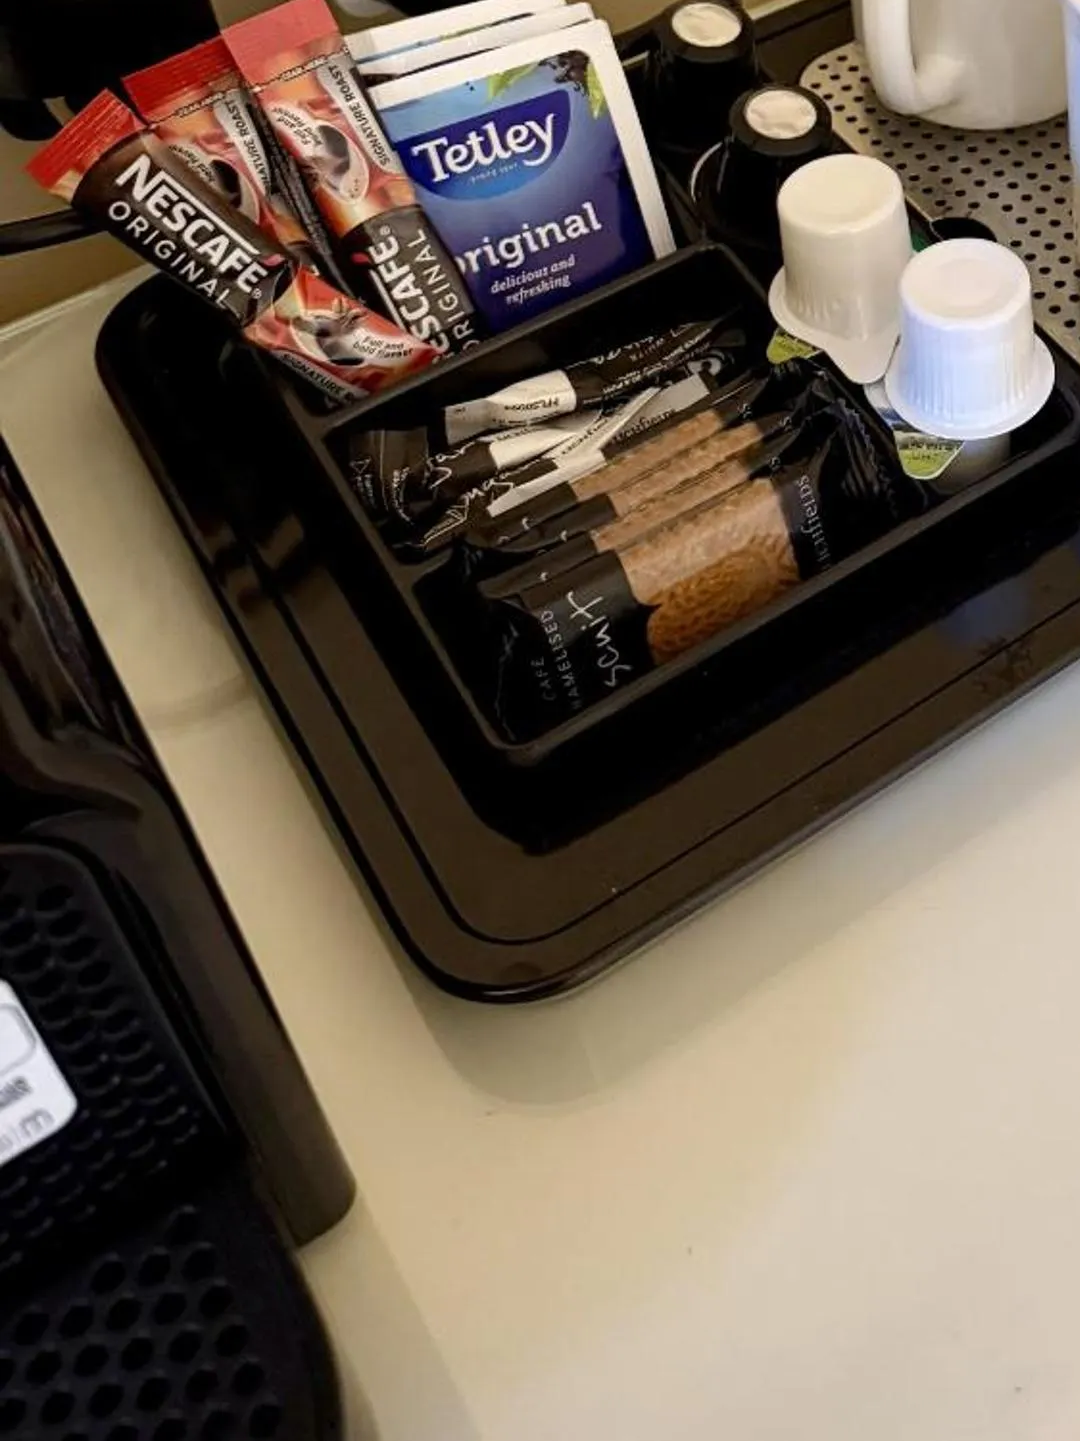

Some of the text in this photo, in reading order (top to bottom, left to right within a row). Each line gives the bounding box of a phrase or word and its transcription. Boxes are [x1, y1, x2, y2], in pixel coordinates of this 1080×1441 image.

[225, 99, 250, 138] ROAST
[328, 64, 391, 167] SIGNATURE ROAST
[411, 113, 557, 183] Tetley
[108, 200, 230, 310] ORIGINAL
[490, 254, 576, 294] delicious and
[504, 274, 572, 306] refreshing
